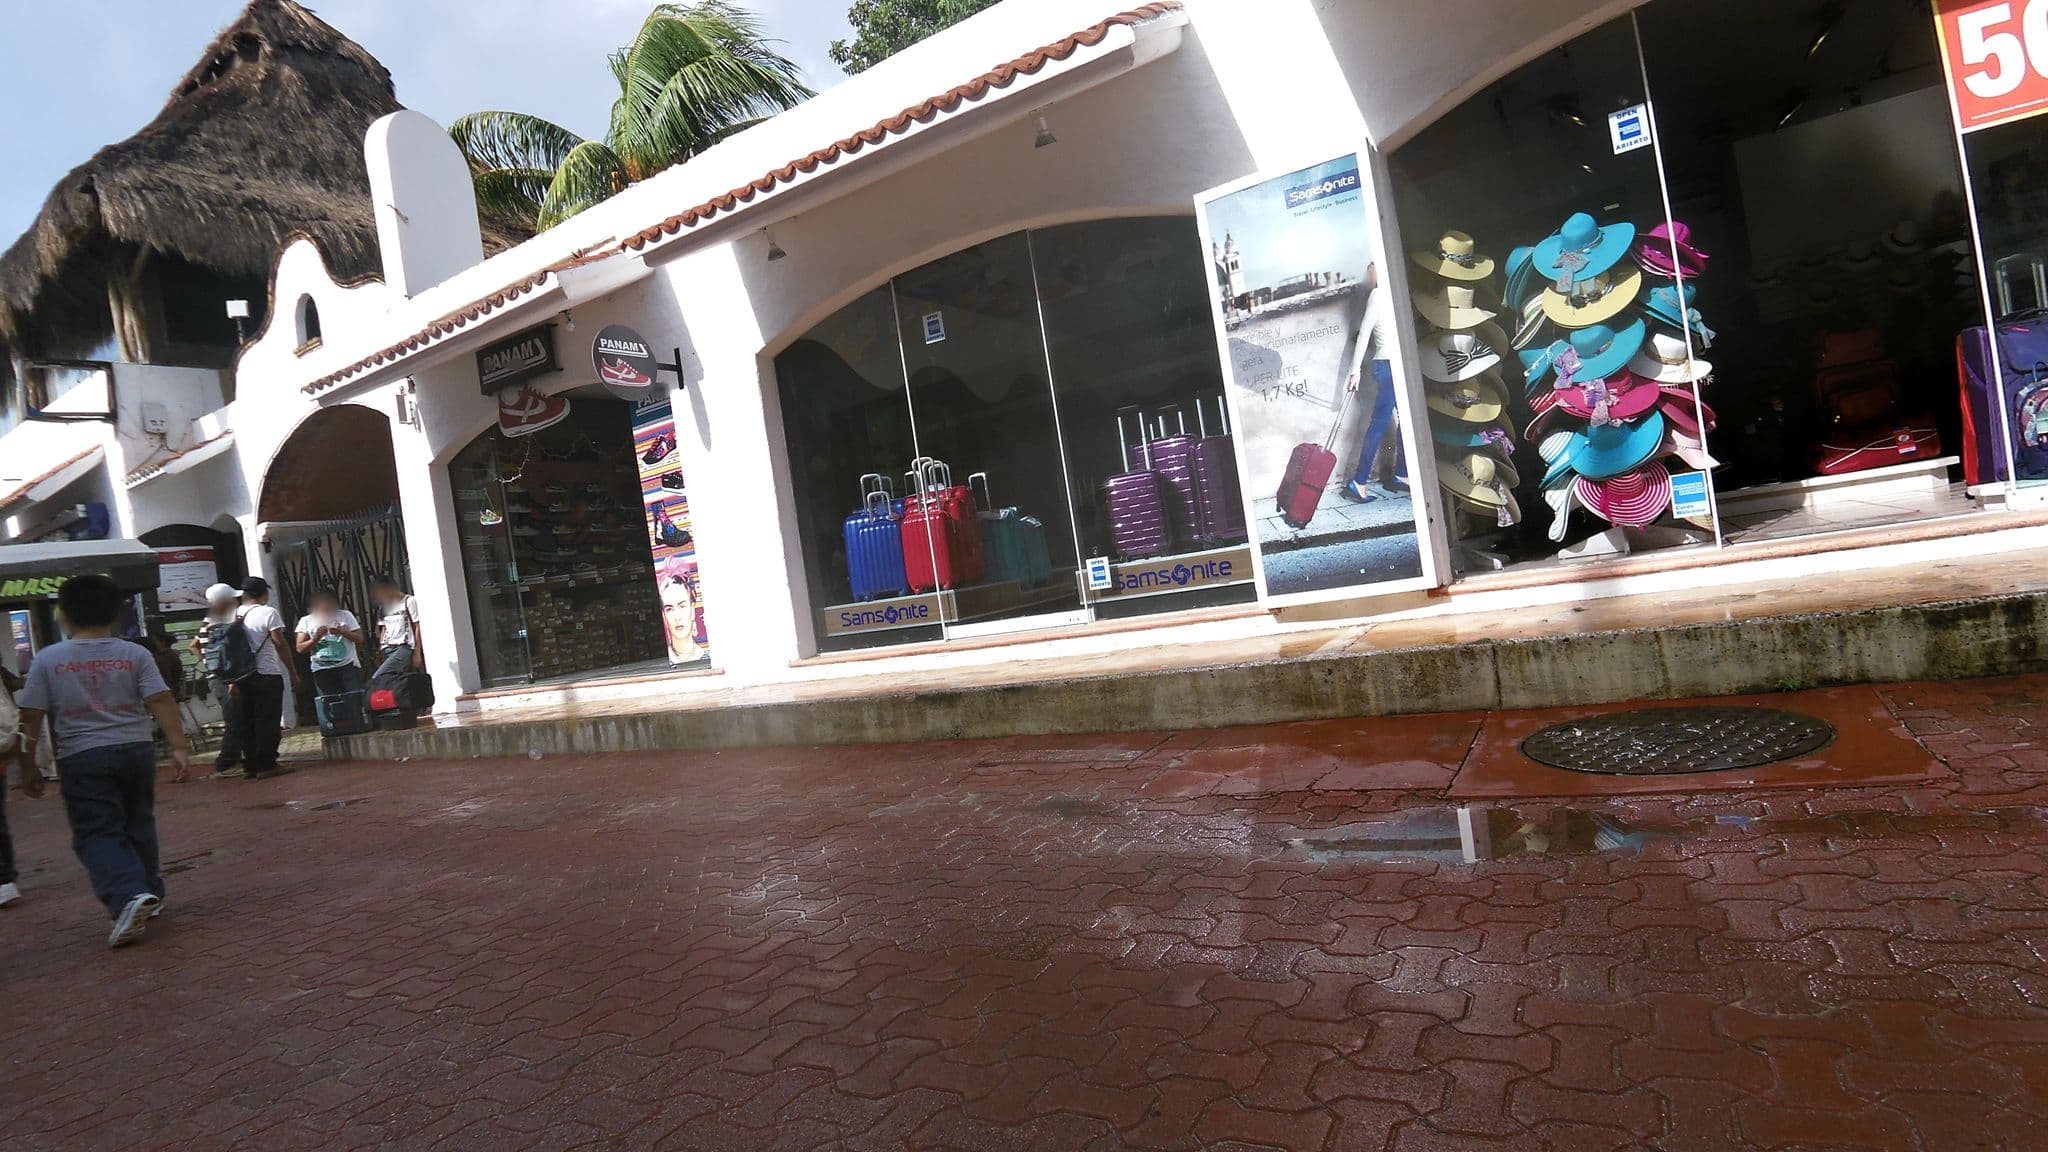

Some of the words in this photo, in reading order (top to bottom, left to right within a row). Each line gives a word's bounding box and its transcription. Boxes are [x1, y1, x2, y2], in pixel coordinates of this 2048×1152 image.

[1616, 107, 1637, 119] OPEN
[1616, 136, 1648, 150] ABIERTO
[1289, 175, 1355, 203] Samsonite
[483, 338, 535, 373] PANAM
[600, 338, 639, 352] PANAM
[1261, 384, 1280, 402] 1,7
[1285, 379, 1308, 398] Kg!
[1118, 560, 1233, 590] Samsonite
[841, 603, 929, 627] Samsonite
